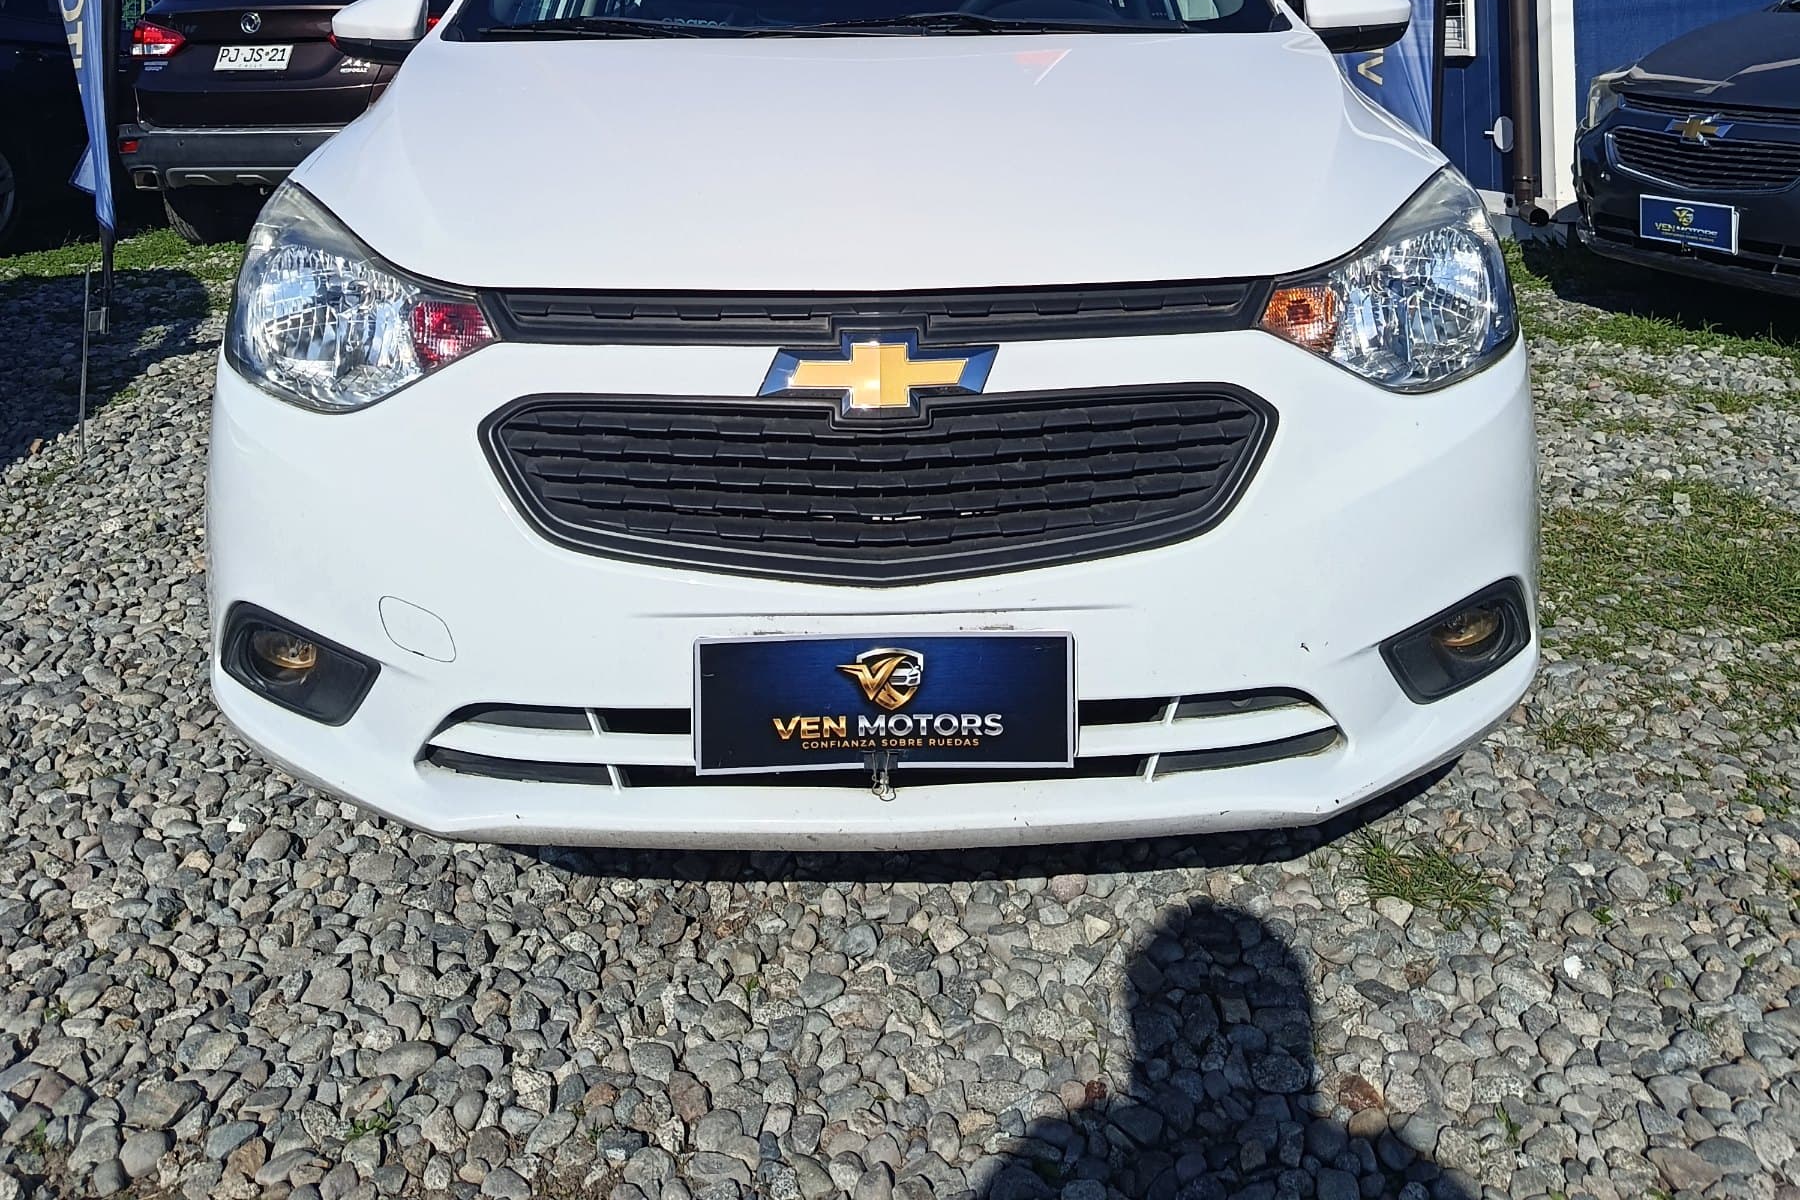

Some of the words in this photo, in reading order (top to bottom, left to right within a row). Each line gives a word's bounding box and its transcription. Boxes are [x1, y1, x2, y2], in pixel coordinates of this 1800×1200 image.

[773, 715, 847, 740] VEN
[857, 713, 1004, 737] MOTORS
[802, 738, 877, 750] CONFIANZA
[881, 738, 923, 747] SOBRE
[928, 738, 980, 747] RUEDAS
